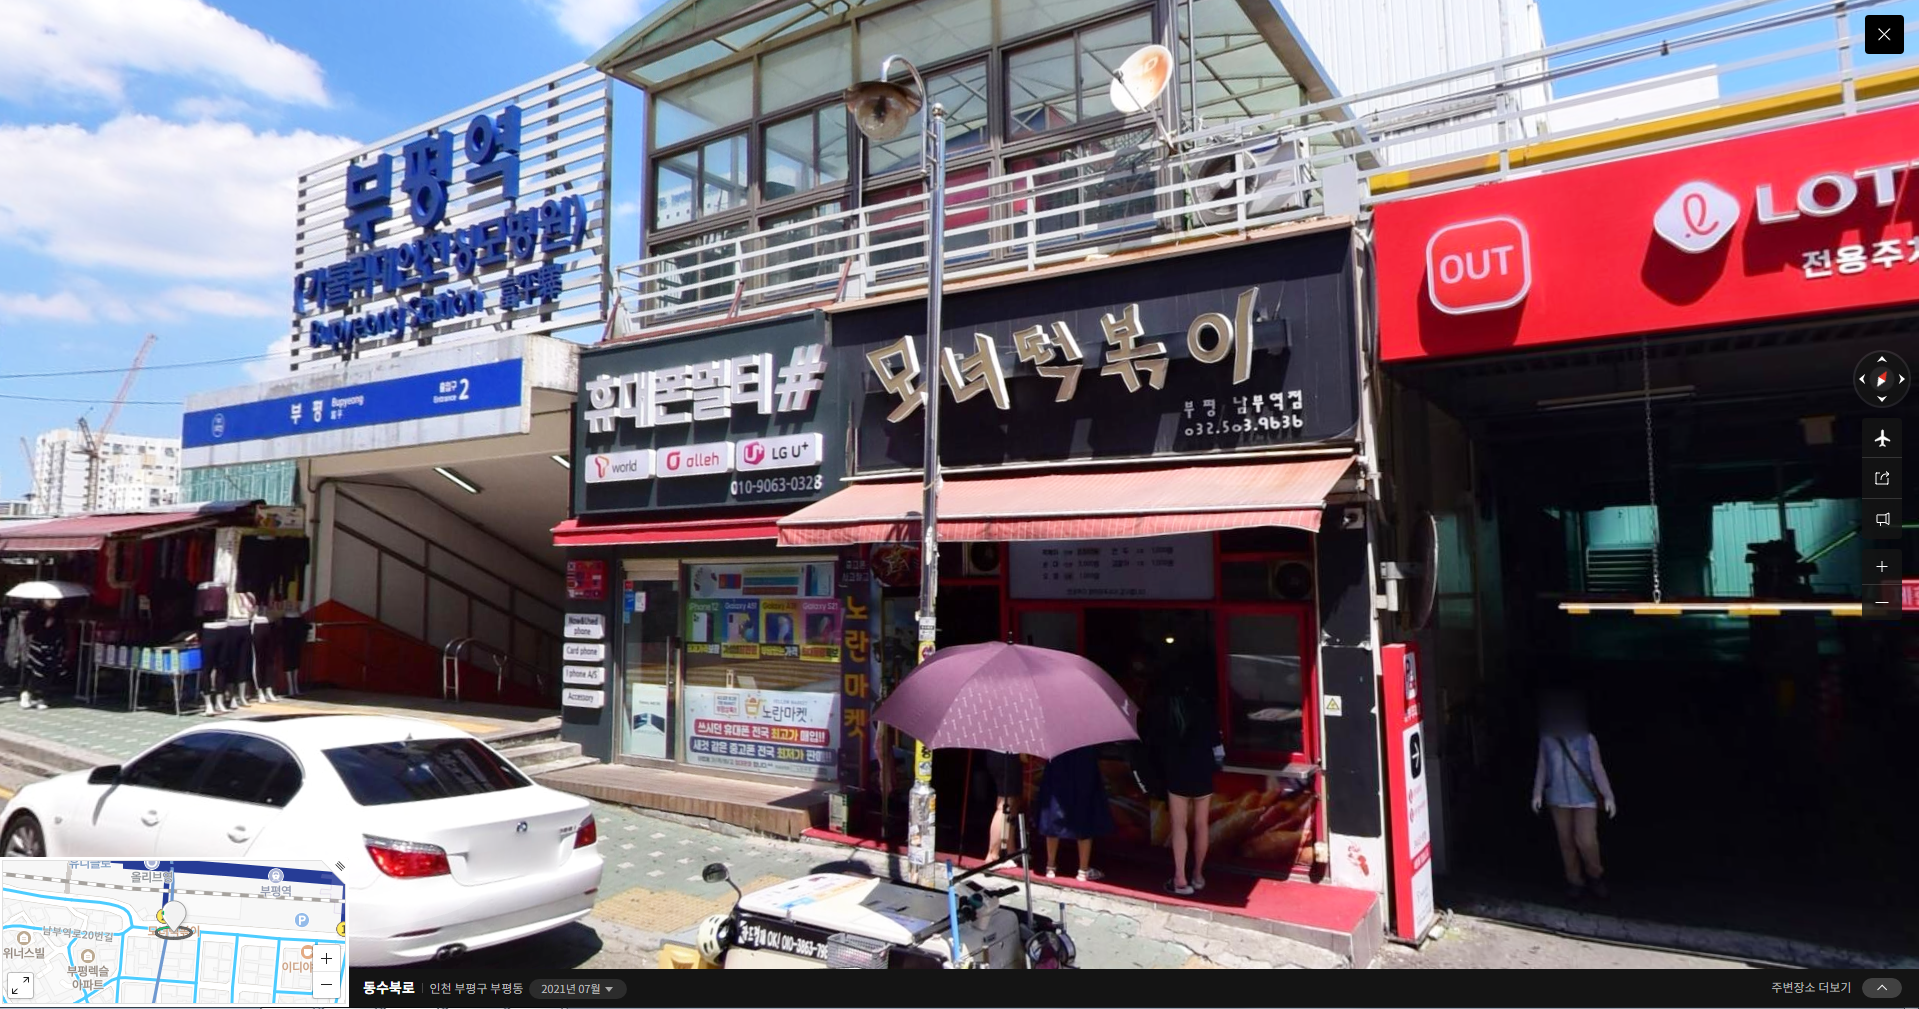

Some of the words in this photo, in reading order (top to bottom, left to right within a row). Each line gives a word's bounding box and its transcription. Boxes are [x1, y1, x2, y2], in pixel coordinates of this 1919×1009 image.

[345, 104, 522, 244] 부평역
[1755, 160, 1919, 225] LOT
[1440, 245, 1514, 284] OUT
[309, 305, 406, 350] Bupyeong
[409, 289, 485, 328] Station
[866, 287, 1260, 423] 모녀떡볶이
[459, 378, 469, 400] 2
[584, 343, 828, 433] 휴대폰멀티#
[331, 395, 364, 408] Bupyeong
[1232, 390, 1304, 414] 남부역점
[291, 400, 323, 425] 부평
[1184, 415, 1304, 436] 032.503.9636
[772, 446, 787, 460] LG
[791, 441, 809, 458] U+
[612, 459, 637, 473] world
[731, 474, 823, 495] 010-9063-0328
[724, 602, 746, 611] Galaxy
[803, 602, 826, 611] Galaxy
[827, 602, 839, 611] S21
[574, 626, 591, 636] phone
[566, 646, 579, 655] Card
[580, 647, 598, 657] phone
[569, 668, 587, 679] phone
[587, 670, 598, 679] A/S
[843, 596, 869, 740] 노란마켓
[567, 691, 594, 703] Accessory
[763, 705, 808, 723] 노란마켓
[697, 723, 722, 735] 쓰시던
[724, 724, 750, 738] 휴대폰
[752, 726, 769, 739] 전국
[771, 727, 799, 742] 최고가
[711, 741, 728, 753] 같은
[729, 742, 756, 755] 중고폰
[758, 746, 775, 758] 전국
[777, 747, 804, 761] 최저가
[767, 930, 781, 949] OK!
